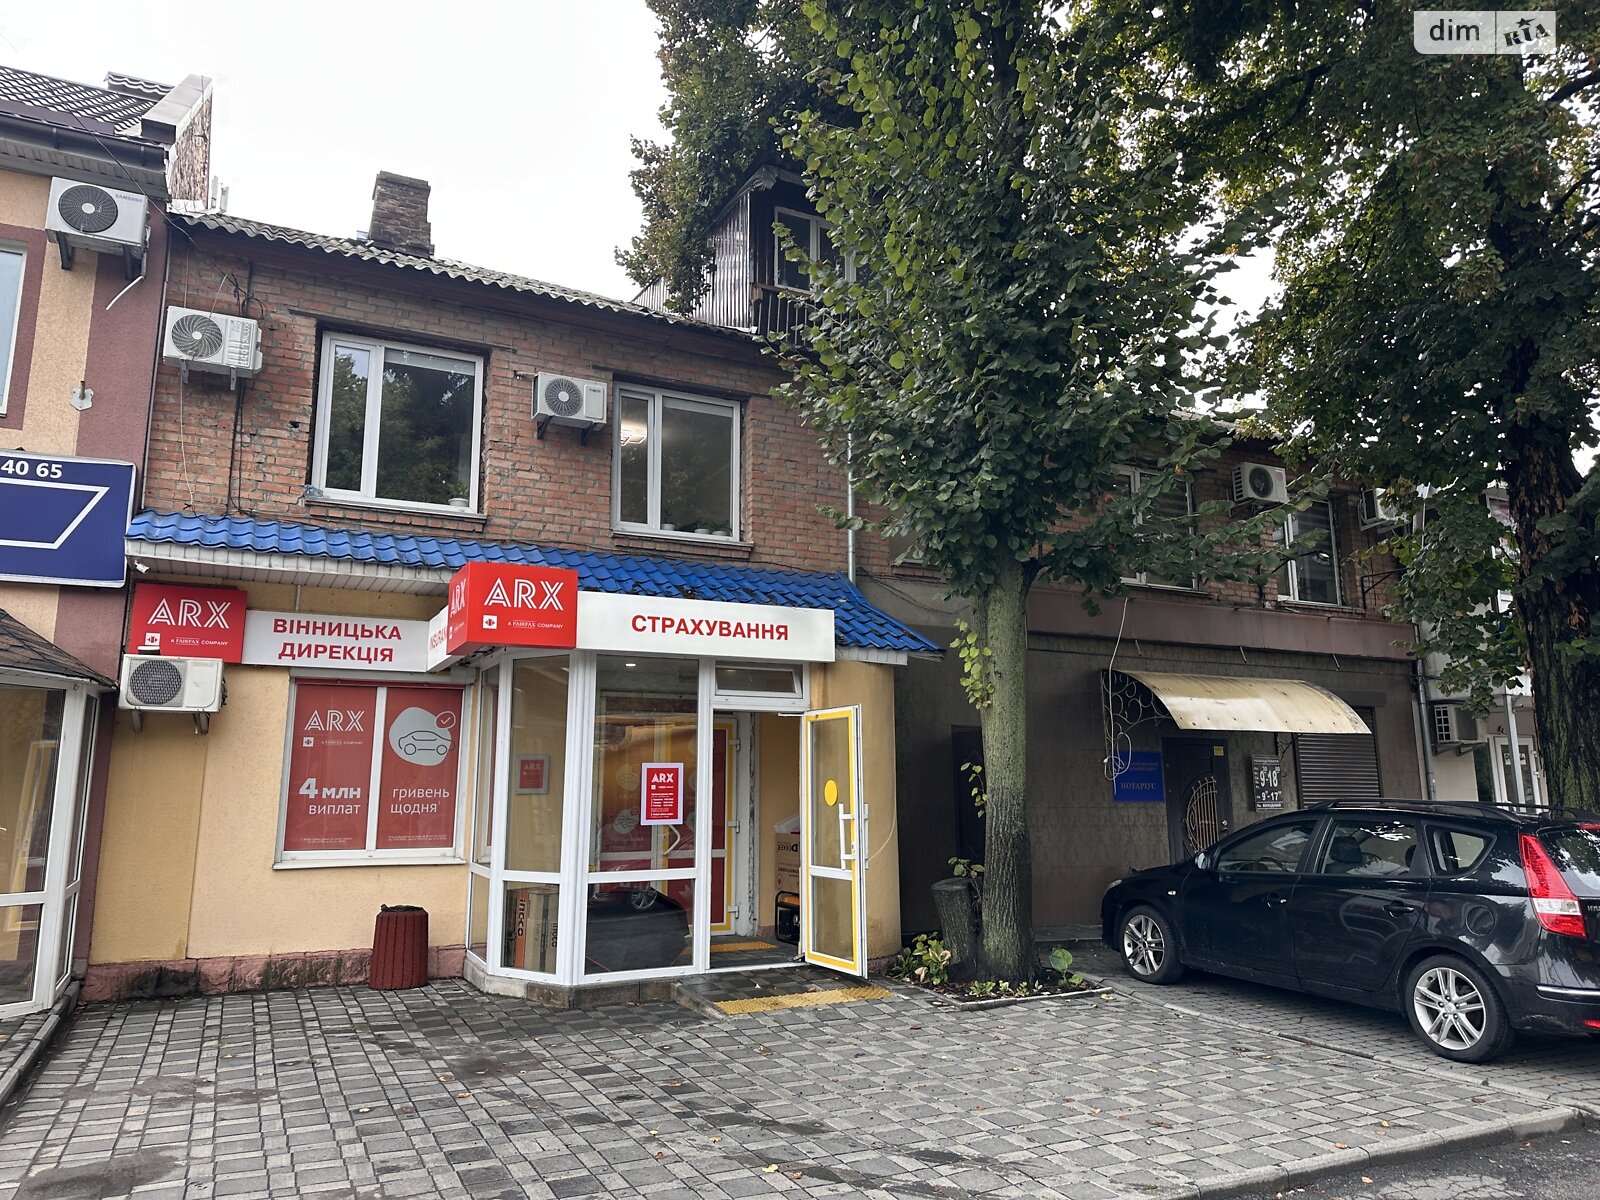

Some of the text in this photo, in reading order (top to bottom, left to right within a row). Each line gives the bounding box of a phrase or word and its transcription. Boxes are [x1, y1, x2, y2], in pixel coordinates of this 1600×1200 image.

[116, 194, 142, 202] SAMSUNG
[1, 459, 63, 479] 40 65
[450, 577, 466, 618] ARX
[484, 577, 564, 611] ARX
[147, 597, 231, 628] ARX
[272, 618, 402, 641] ВІННИЦЬКА
[631, 614, 788, 641] СТРАХУВАННЯ
[278, 642, 394, 664] ДИРЕКЦІЯ
[304, 710, 365, 732] ARX
[298, 778, 361, 799] 4 млн
[652, 773, 674, 782] ARX
[392, 788, 450, 800] гривень
[309, 803, 361, 815] виплат
